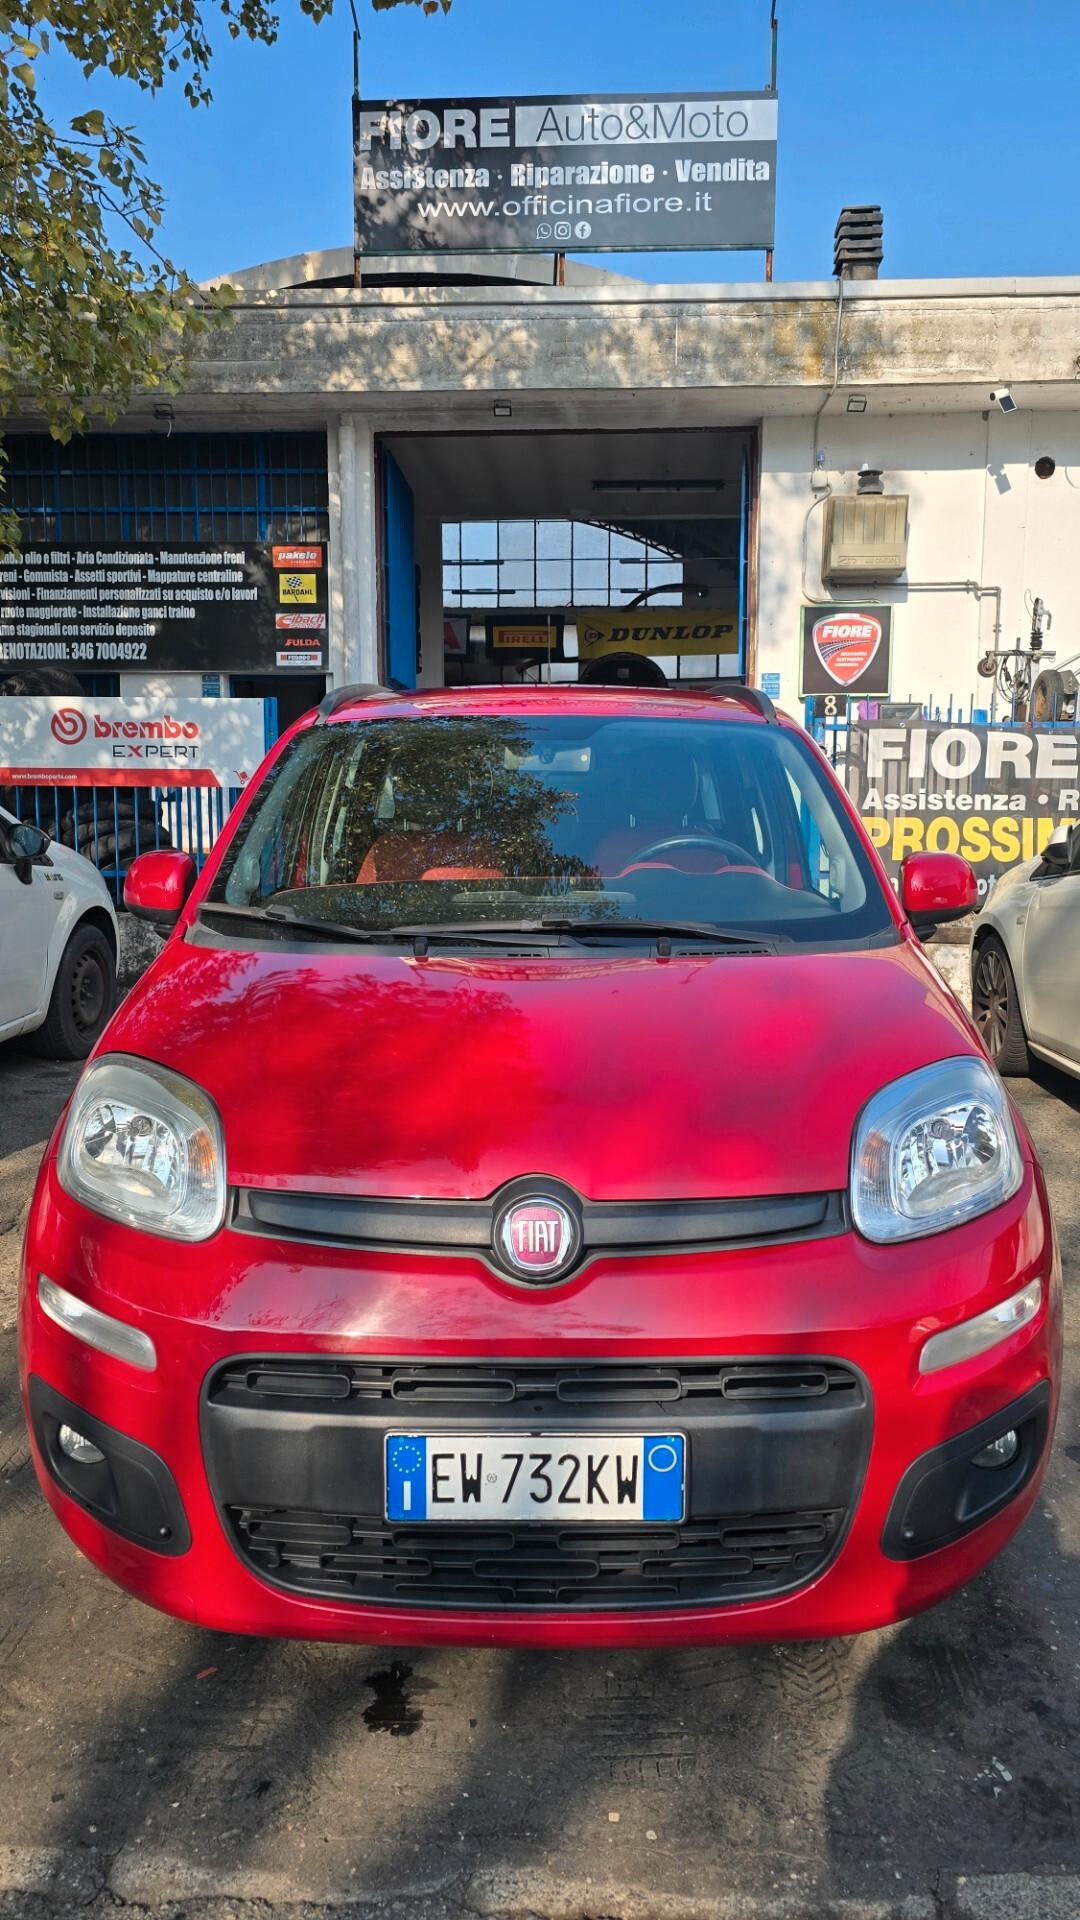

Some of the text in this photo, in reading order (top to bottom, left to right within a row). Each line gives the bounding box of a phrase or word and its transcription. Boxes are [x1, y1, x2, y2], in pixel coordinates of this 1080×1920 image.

[358, 107, 511, 151] FIORE
[535, 102, 749, 143] Auto&Moto
[360, 164, 490, 191] Assistenza
[510, 160, 655, 189] Riparazione
[674, 157, 771, 184] Vendita
[417, 191, 712, 218] www.officinafiore.it
[25, 551, 42, 565] olio
[43, 553, 50, 565] e
[50, 551, 71, 565] filtri
[77, 551, 95, 565] Aria
[96, 550, 154, 565] Condizionata
[160, 551, 222, 565] Manutenzione
[223, 551, 245, 565] freni
[23, 569, 69, 583] Gommista
[75, 569, 105, 582] Assetti
[106, 569, 142, 583] sportivi
[147, 569, 197, 584] Mappature
[197, 569, 244, 583] centraline
[36, 587, 98, 600] Finanziamenti
[99, 587, 161, 601] personalizzati
[162, 589, 174, 601] su
[175, 587, 214, 602] acquisto
[215, 588, 231, 600] e/o
[232, 587, 258, 601] lavori
[282, 588, 314, 596] BARDAHL
[1, 606, 25, 618] ruote
[26, 605, 77, 620] maggiorate
[83, 605, 141, 618] Installazione
[142, 605, 168, 620] ganci
[168, 606, 196, 618] traino
[16, 623, 61, 637] stagionali
[62, 624, 79, 636] con
[80, 622, 115, 636] servizio
[116, 622, 156, 637] deposito
[607, 624, 733, 642] DUNLOP
[822, 625, 874, 638] FIORE
[71, 642, 94, 660] 346
[96, 642, 148, 660] 7004922
[285, 638, 320, 646] FULDA
[824, 695, 837, 716] 8
[94, 715, 199, 739] brembo
[112, 744, 199, 758] EXPERT
[866, 728, 1079, 779] FIORE
[862, 788, 1026, 811] Assistenza
[517, 1220, 559, 1253] FIAT
[431, 1453, 639, 1505] EW 732KW
